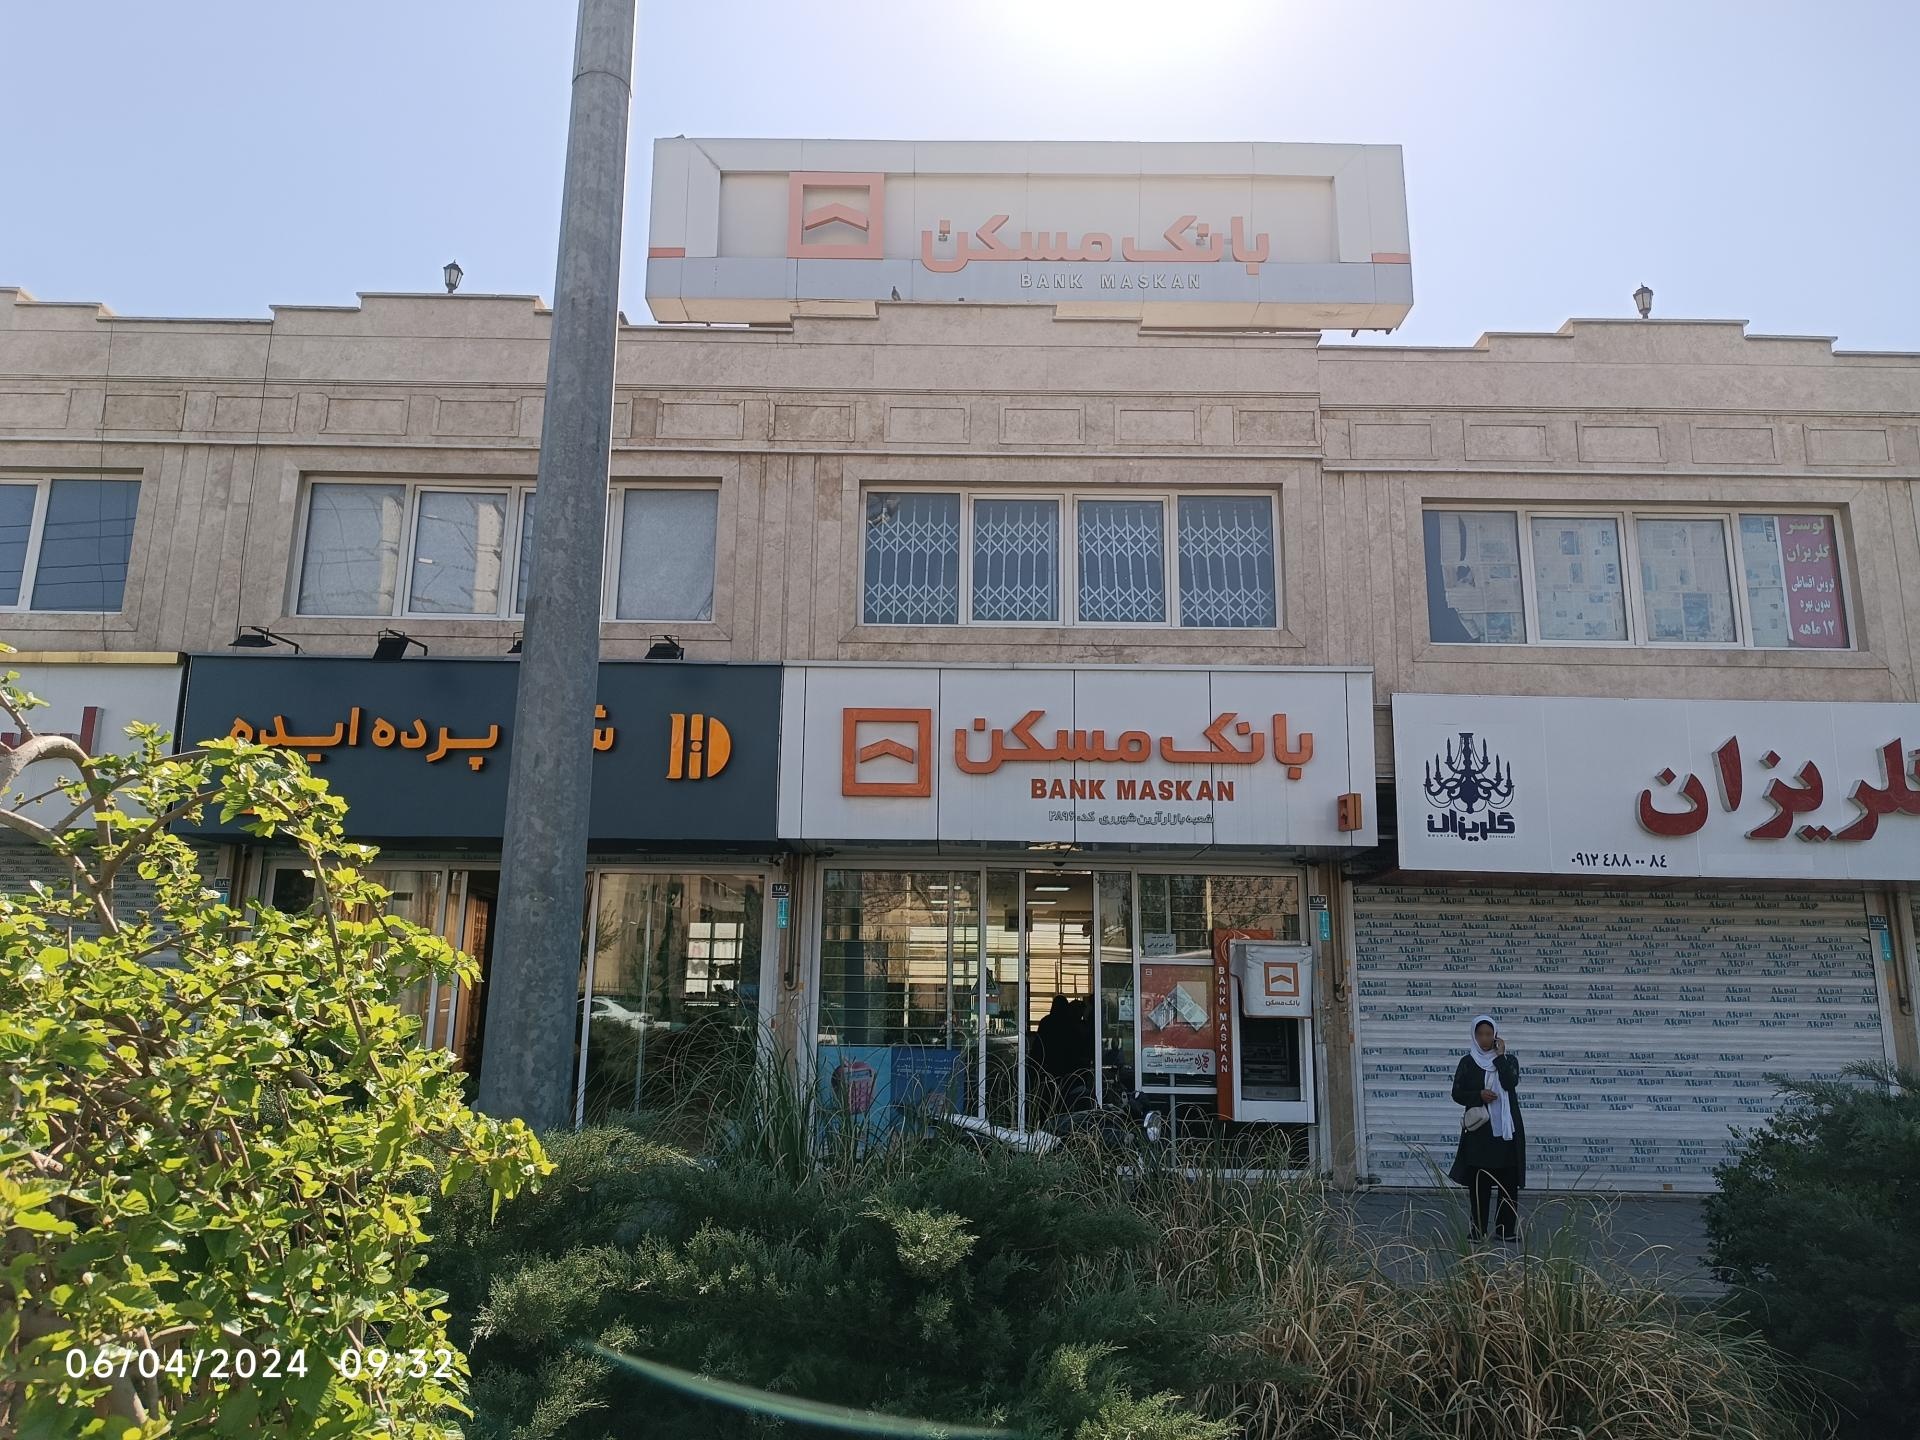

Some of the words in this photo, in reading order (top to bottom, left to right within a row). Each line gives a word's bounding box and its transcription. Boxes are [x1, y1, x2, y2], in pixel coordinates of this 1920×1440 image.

[921, 215, 1112, 272] مسکن
[1123, 215, 1269, 275] بانک
[1019, 272, 1084, 290] BANK
[1101, 273, 1202, 290] MASKAN
[229, 706, 361, 762] ایده
[371, 716, 499, 771] پرده
[954, 710, 1152, 774] مسکن
[1160, 712, 1314, 780] بانک
[1031, 778, 1105, 800] BANK
[1116, 780, 1235, 802] MASKAN
[1427, 808, 1515, 842] گلریزان
[1218, 967, 1226, 1006] BANK
[1265, 999, 1285, 1007] مسکن
[1285, 999, 1300, 1007] بانک
[1219, 1012, 1229, 1073] MASKAN
